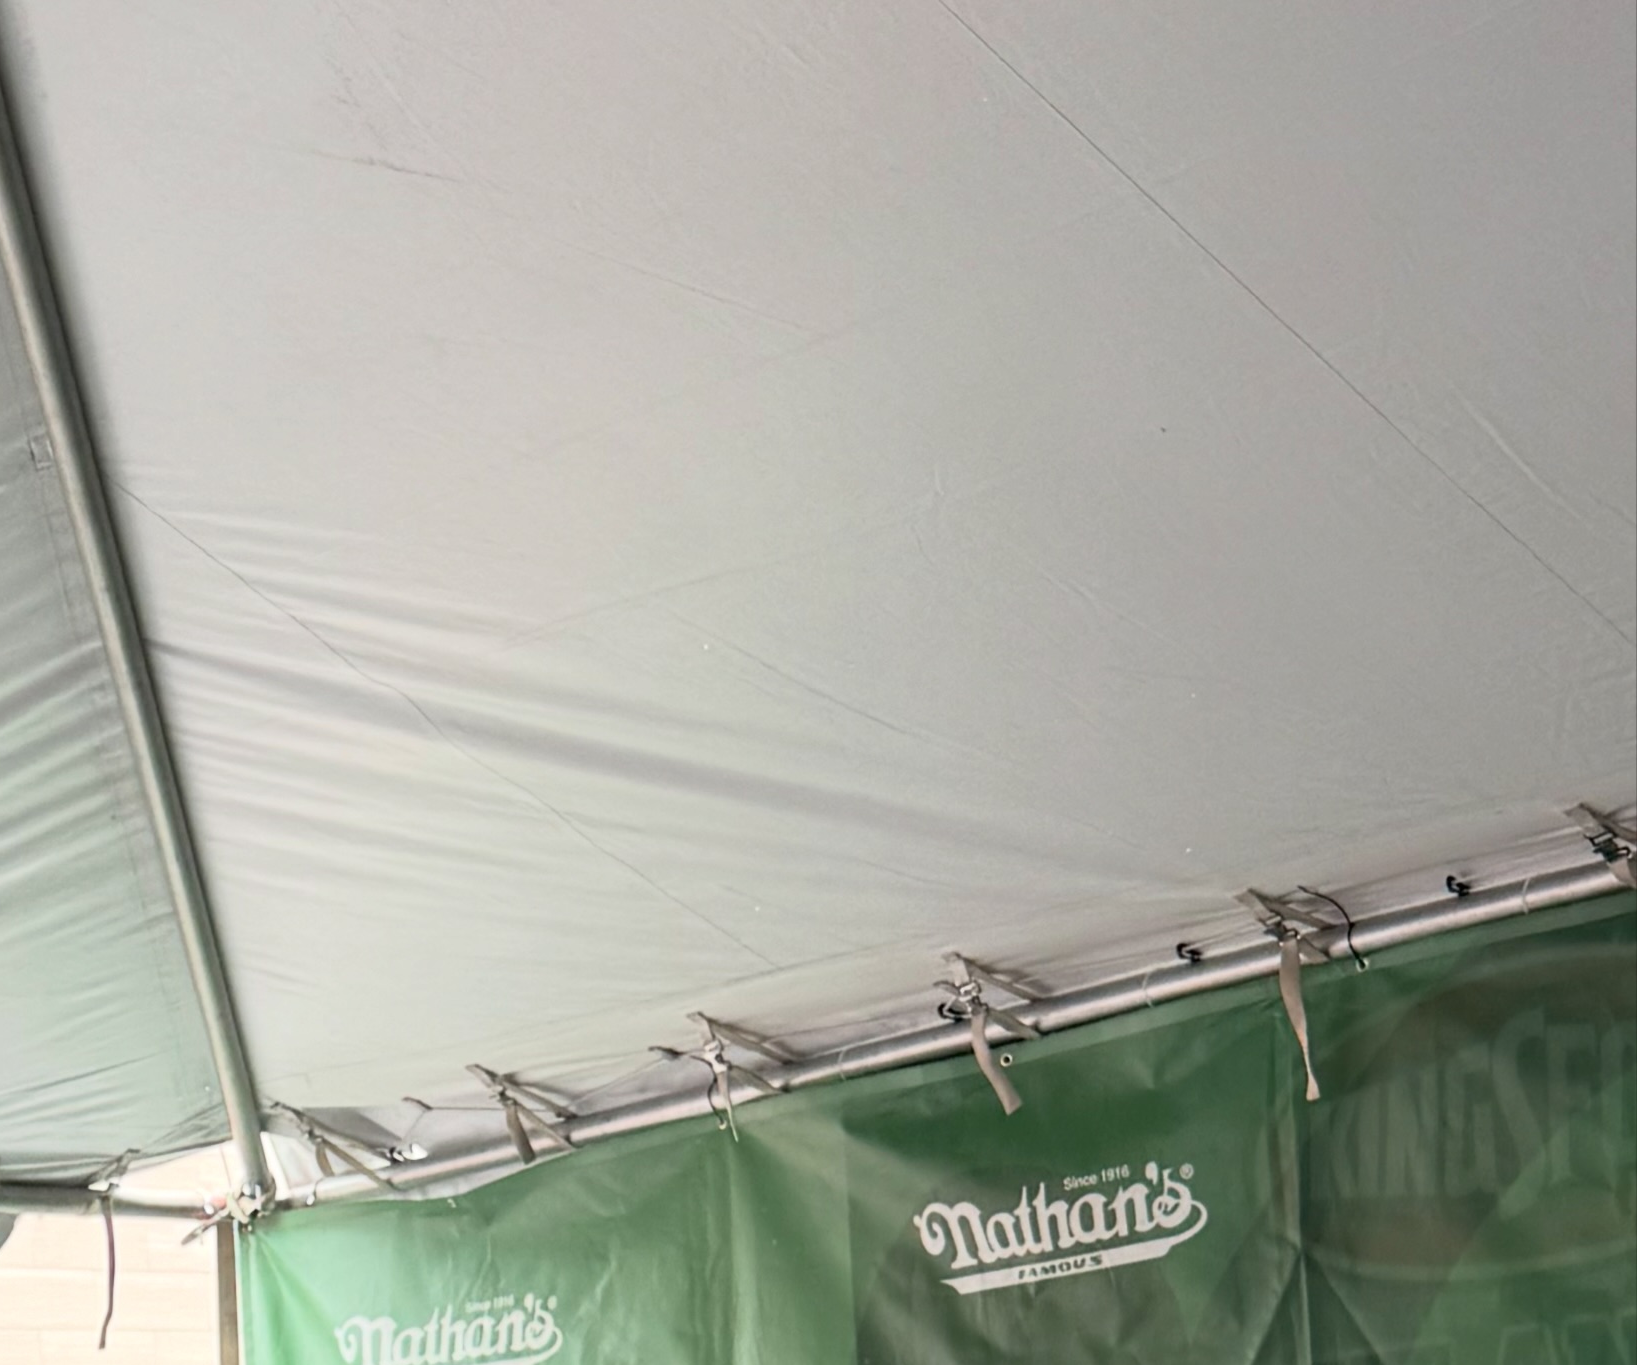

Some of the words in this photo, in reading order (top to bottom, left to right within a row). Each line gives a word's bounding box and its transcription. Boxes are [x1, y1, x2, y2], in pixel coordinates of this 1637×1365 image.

[1063, 1171, 1098, 1193] Since
[1099, 1164, 1131, 1187] 1916
[913, 1161, 1205, 1270] Nathan's
[1016, 1254, 1105, 1281] FAMOUS
